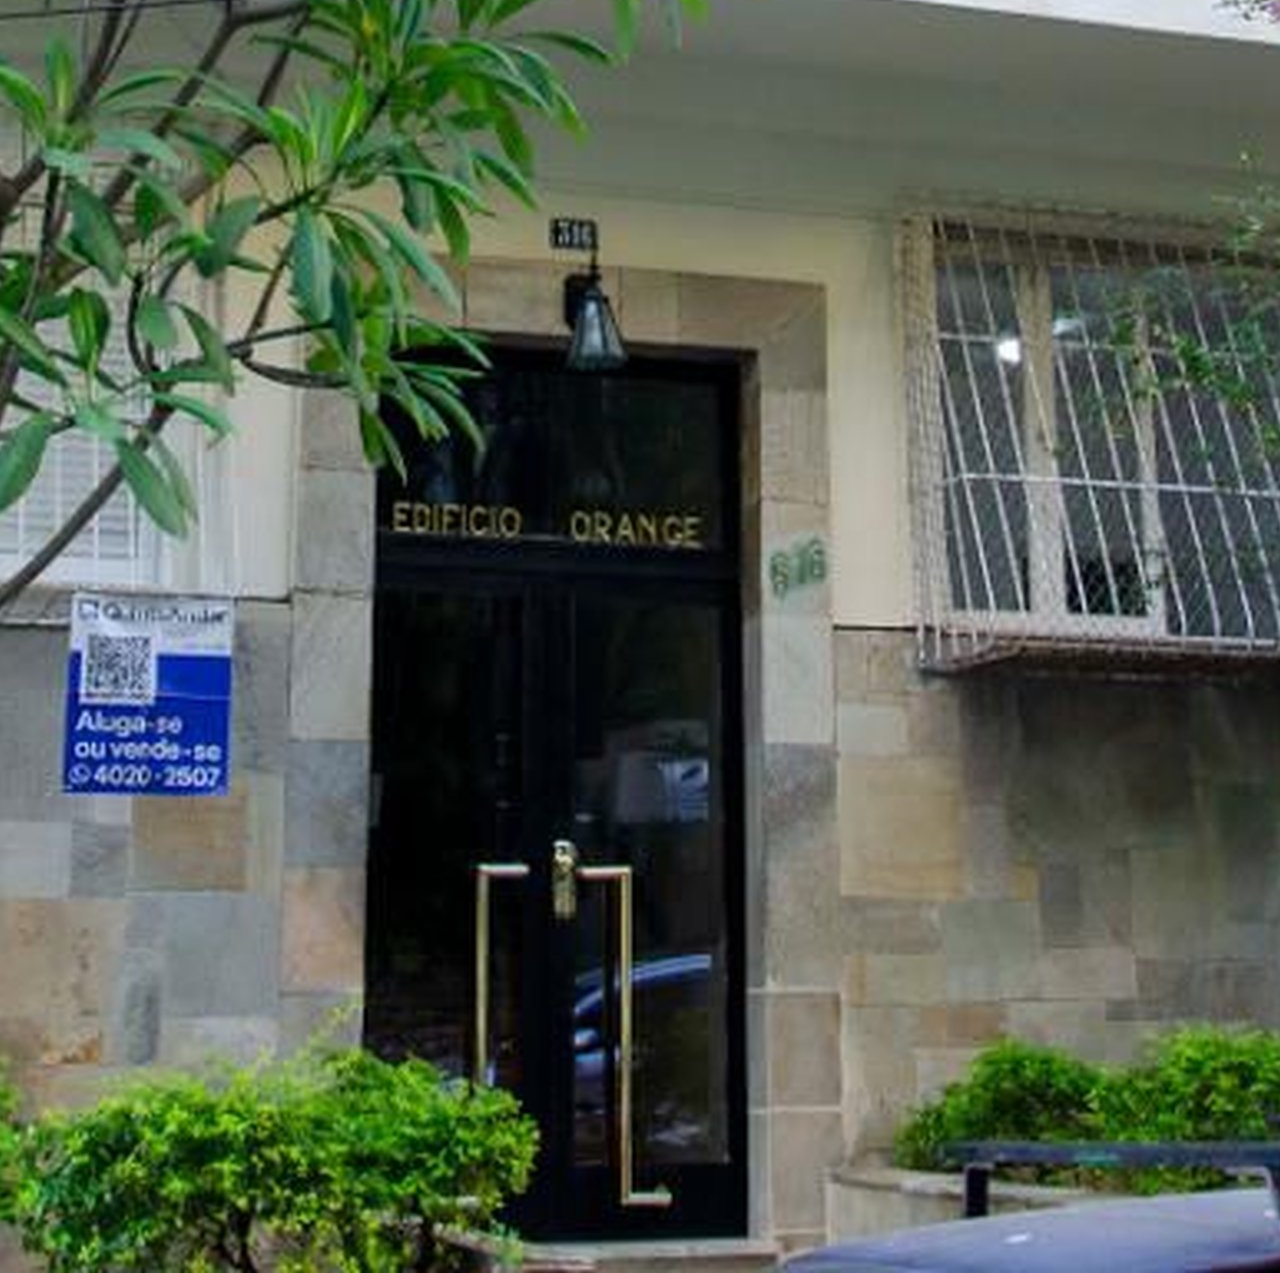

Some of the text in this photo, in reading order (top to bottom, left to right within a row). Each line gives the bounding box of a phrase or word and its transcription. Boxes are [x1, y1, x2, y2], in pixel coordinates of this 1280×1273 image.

[392, 502, 705, 550] EDIFICIO ORANGE
[74, 710, 183, 737] Aluga-se
[74, 739, 222, 762] ou vende-se
